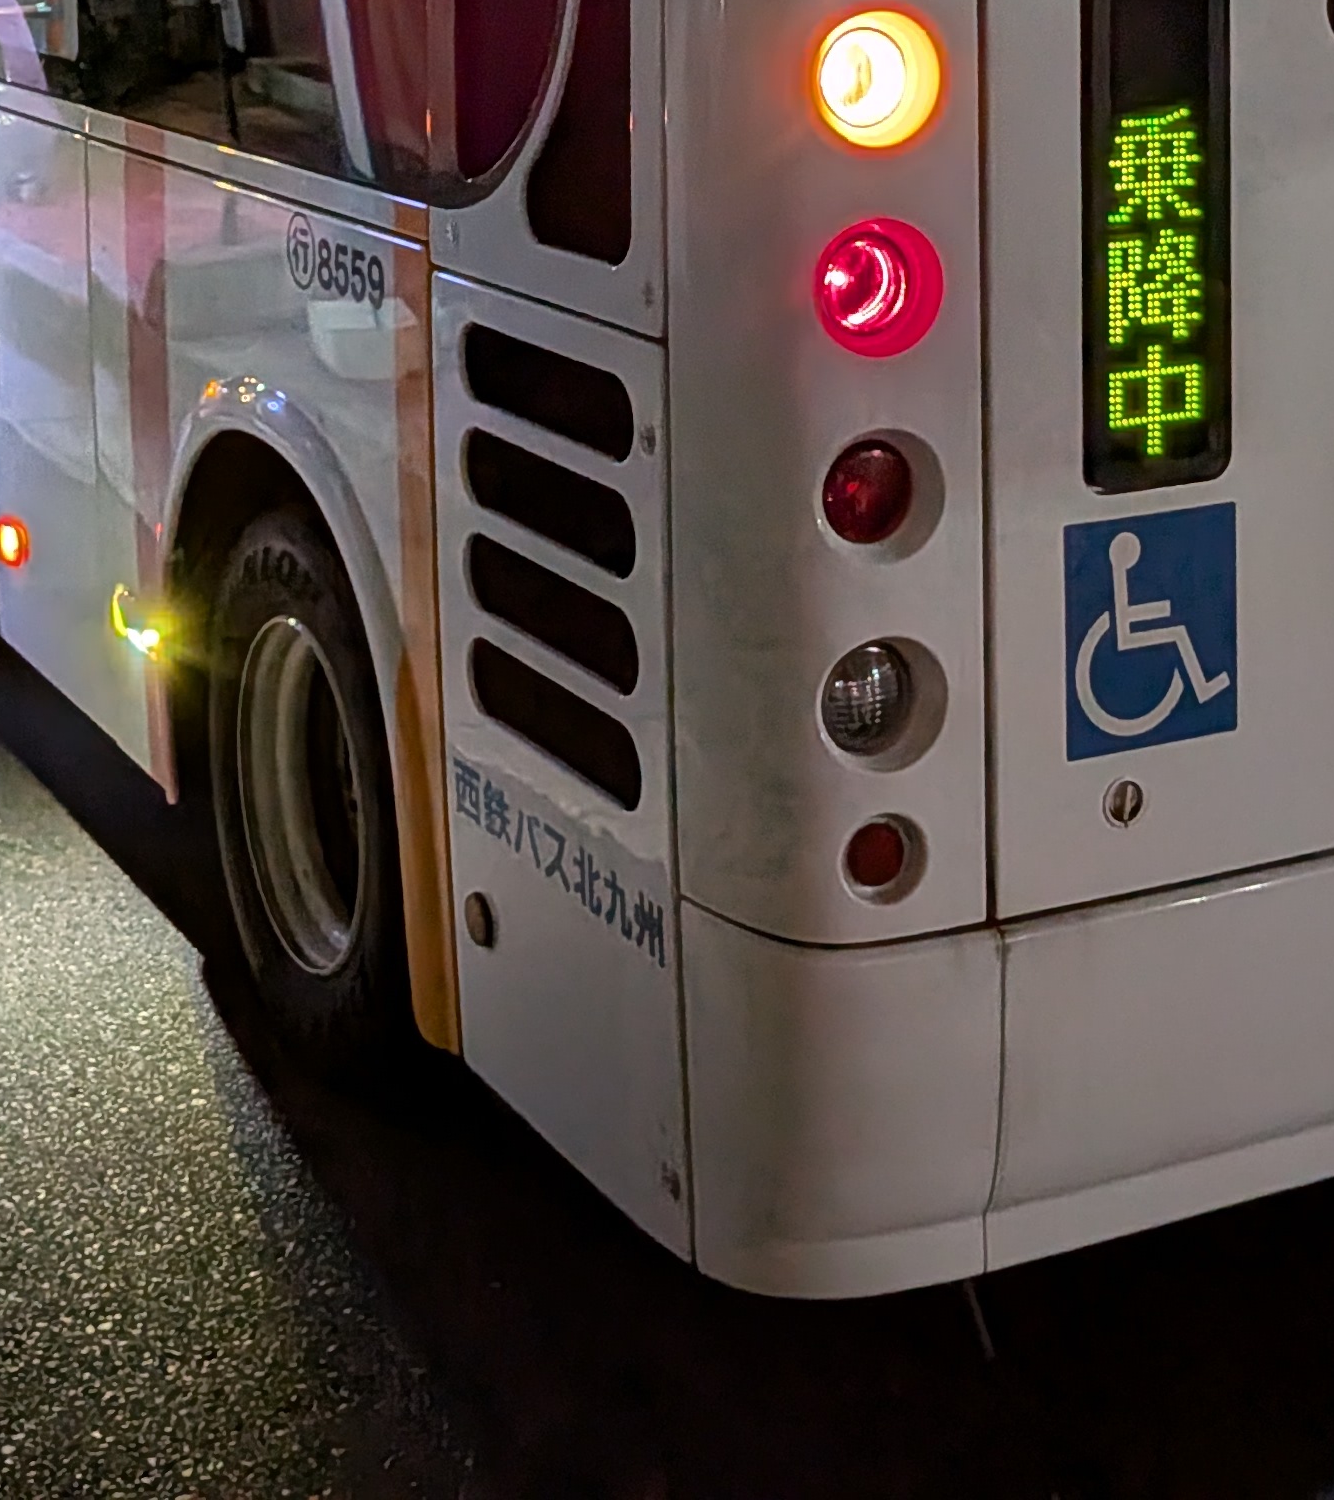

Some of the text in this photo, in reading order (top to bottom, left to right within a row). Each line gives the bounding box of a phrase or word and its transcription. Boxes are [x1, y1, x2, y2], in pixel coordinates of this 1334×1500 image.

[317, 238, 385, 310] 8559
[1107, 107, 1203, 456] 乗降中
[452, 756, 666, 969] 西鉄バス北九州
